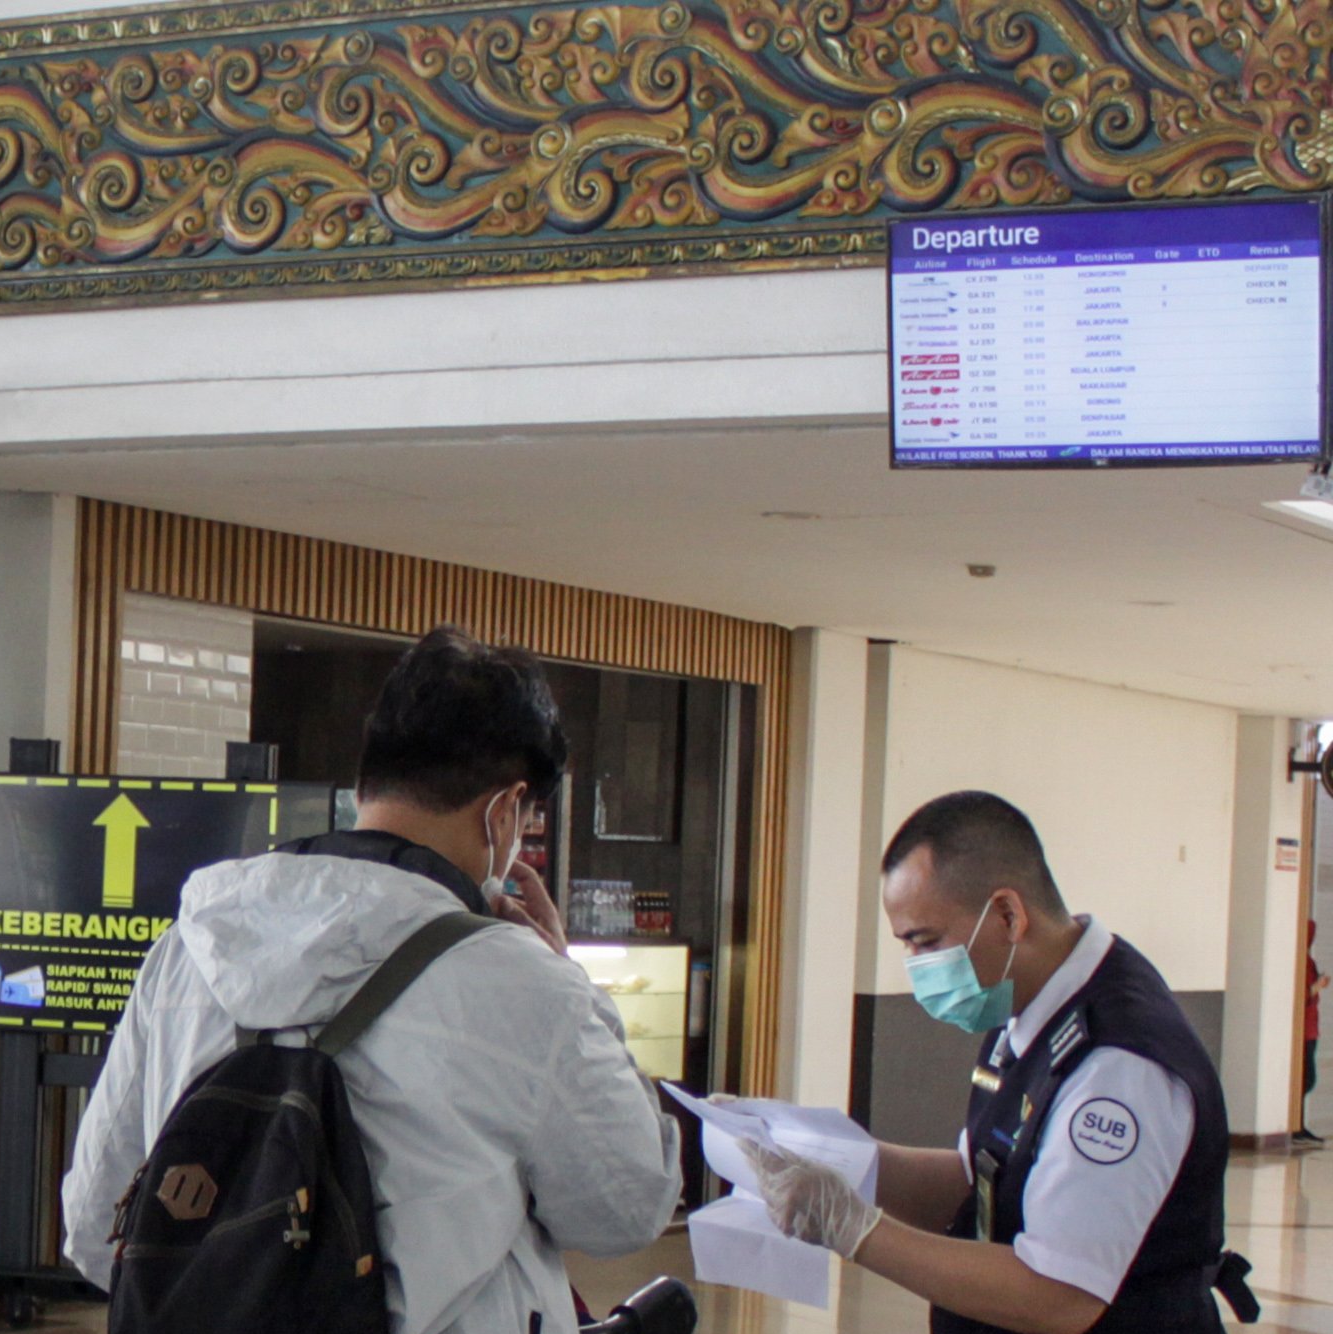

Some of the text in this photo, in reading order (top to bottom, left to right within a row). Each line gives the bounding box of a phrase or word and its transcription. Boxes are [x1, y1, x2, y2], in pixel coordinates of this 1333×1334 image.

[912, 225, 1040, 253] Departure
[914, 245, 1291, 270] Airline Flight Schedule Destination Gate ETD Remark
[1084, 286, 1121, 294] JAKARTA
[1246, 280, 1275, 288] CHECK
[1084, 302, 1121, 310] JAKARTA
[1246, 296, 1275, 305] CHECK
[1278, 296, 1287, 304] IN
[1085, 333, 1122, 342] JAKARTA
[1085, 350, 1122, 358] JAKARTA
[1085, 429, 1122, 438] JAKARTA
[997, 450, 1028, 459] THANK
[1090, 447, 1123, 457] DALAM
[1125, 447, 1163, 457] RANGKA
[1165, 446, 1239, 457] MENINGKATKAN
[1240, 445, 1286, 455] FASILITAS
[46, 964, 106, 979] SIAPKAN
[46, 980, 133, 996] RAPID/ SWAB
[45, 995, 93, 1010] MASUK
[1083, 1112, 1126, 1138] SUB
